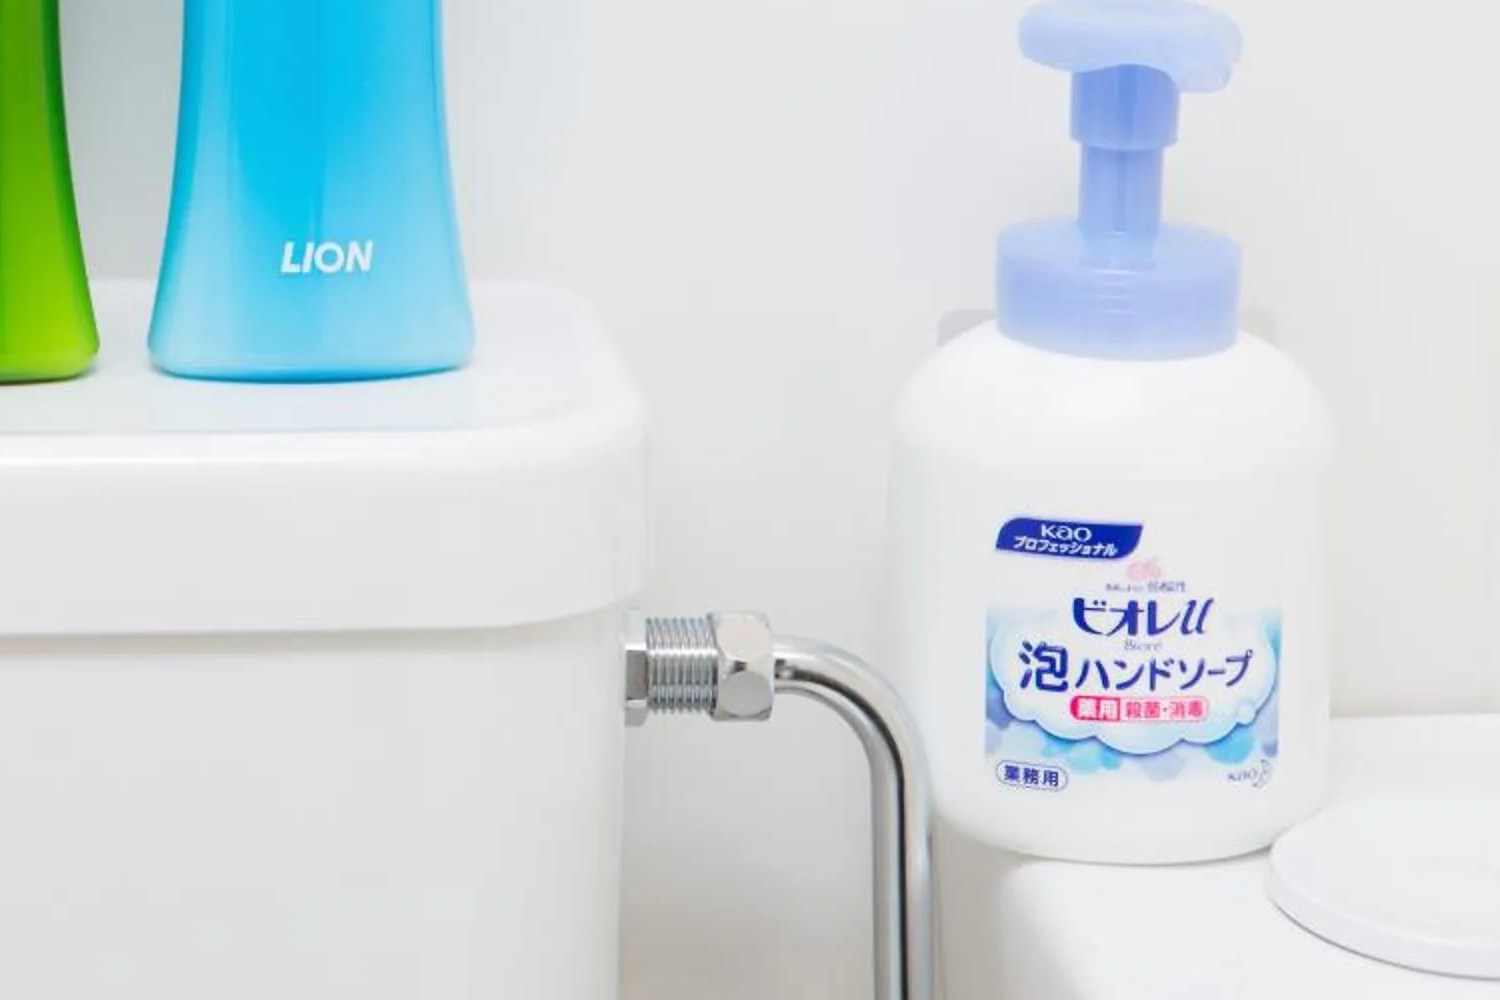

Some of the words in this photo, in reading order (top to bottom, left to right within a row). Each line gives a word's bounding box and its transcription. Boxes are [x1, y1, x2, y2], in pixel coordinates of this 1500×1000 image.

[281, 240, 373, 273] LION
[1013, 535, 1119, 556] プロフェッショナル
[1019, 641, 1253, 692] 泡ハンドソープ
[1004, 765, 1059, 787] 業務用
